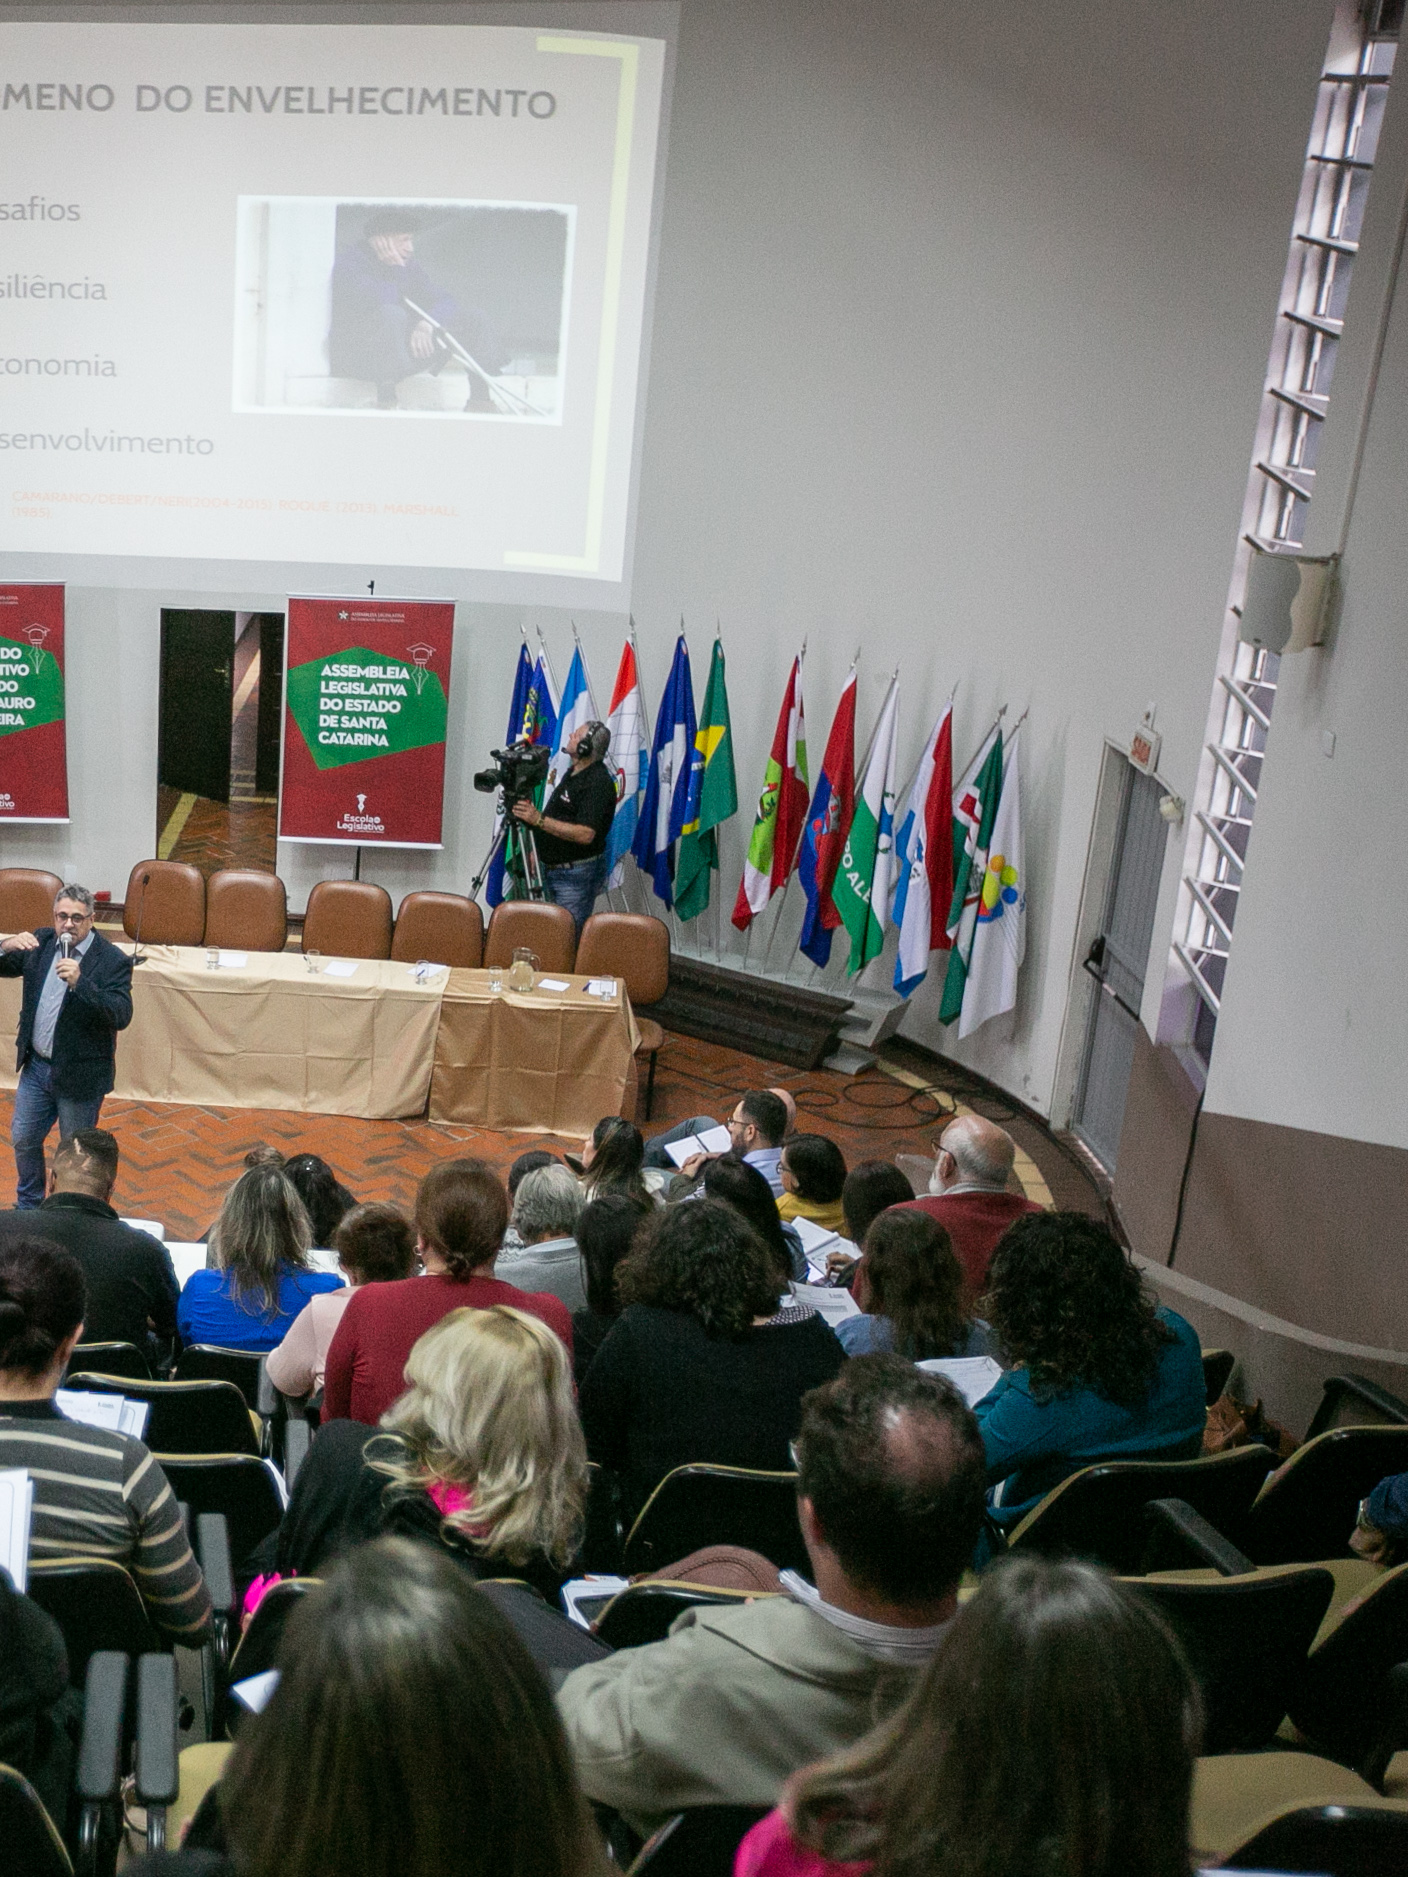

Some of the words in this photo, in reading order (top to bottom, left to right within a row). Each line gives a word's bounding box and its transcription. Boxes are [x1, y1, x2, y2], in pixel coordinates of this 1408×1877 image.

[135, 84, 192, 113] DO
[204, 85, 557, 119] ENVELHECIMENTO
[0, 647, 22, 660] DO
[320, 664, 410, 680] ASSEMBLEIA
[320, 681, 408, 697] LEGISLATIVA
[320, 698, 343, 711] DO
[344, 699, 402, 714] ESTADO
[319, 714, 339, 728] DE
[340, 715, 388, 730] SANTA
[318, 731, 390, 747] CATARINA
[337, 820, 385, 832] Legislativo
